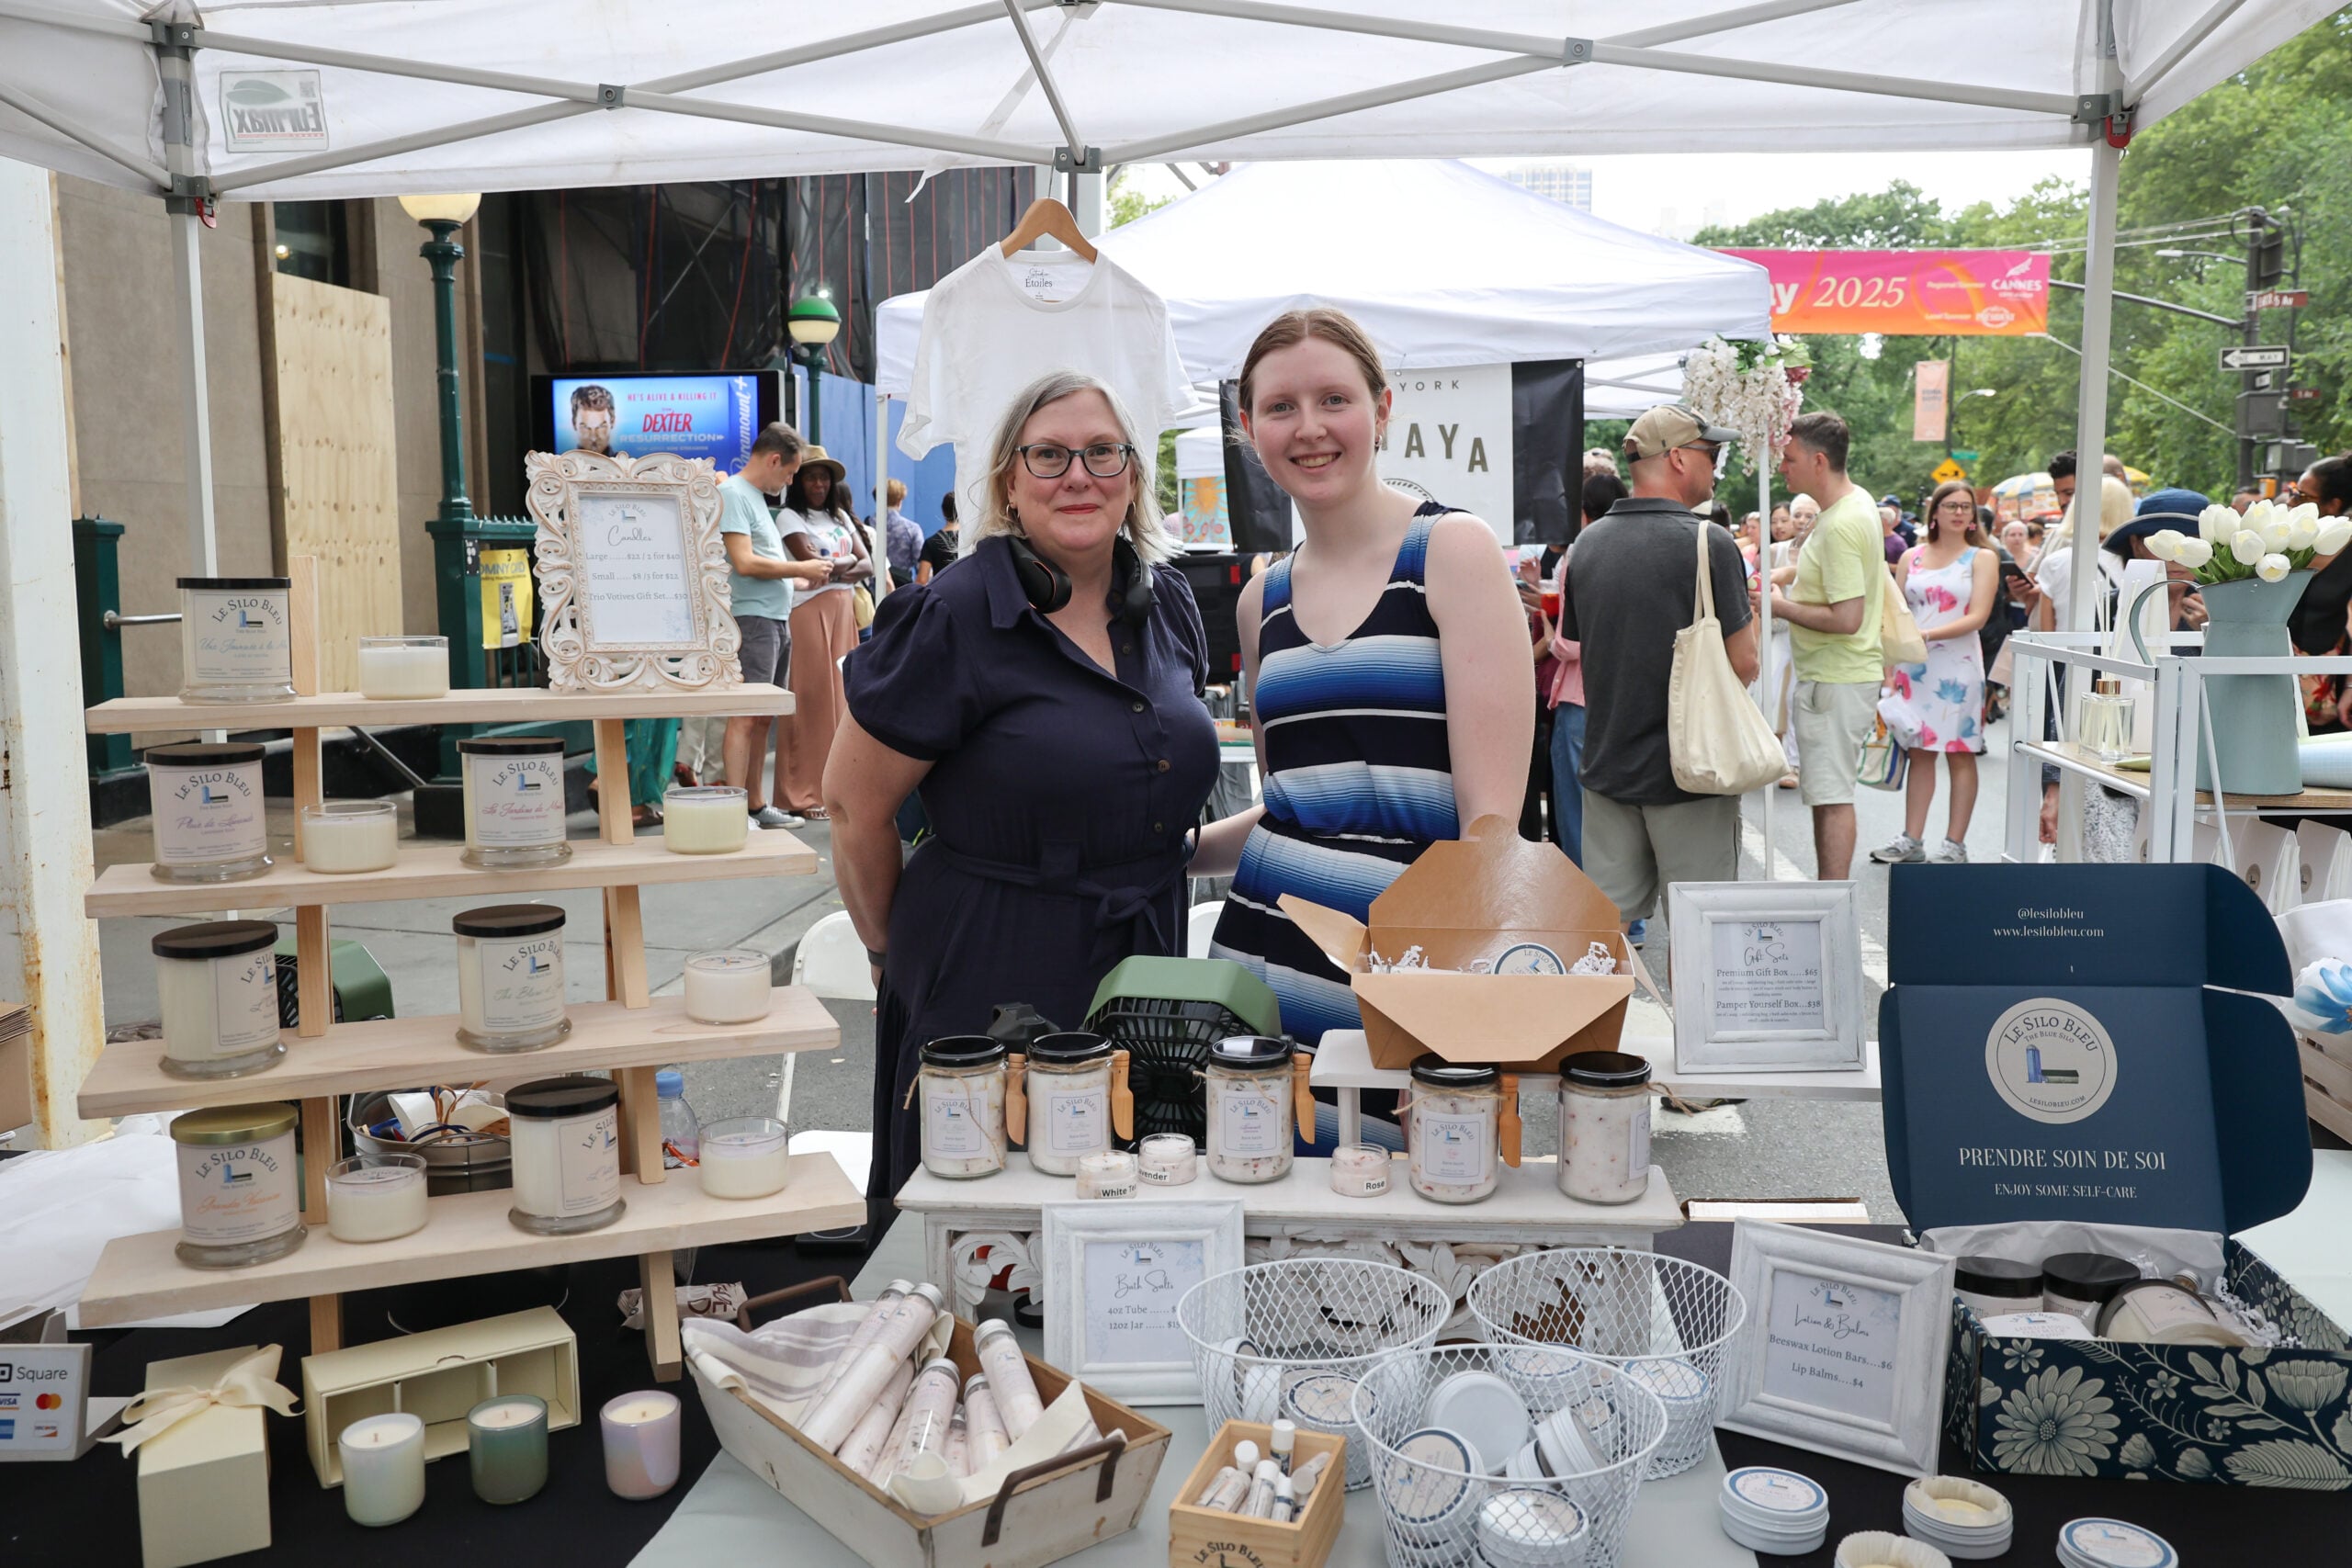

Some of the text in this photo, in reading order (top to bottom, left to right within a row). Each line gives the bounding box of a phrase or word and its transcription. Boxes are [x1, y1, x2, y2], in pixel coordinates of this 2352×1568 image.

[1813, 276, 1906, 308] 2025
[1991, 279, 2042, 291] CANNES
[1399, 380, 1459, 392] YORK
[647, 393, 667, 401] ALIVE
[678, 391, 707, 401] KILLING
[709, 391, 718, 400] IT
[642, 410, 692, 433] DEXTER
[619, 433, 718, 443] RESURRECTION
[607, 525, 651, 547] Candles
[586, 552, 608, 561] Large
[653, 552, 664, 560] for
[592, 572, 615, 581] Small
[211, 598, 282, 626] LE SILO BLEU
[492, 761, 558, 786] LE SILO BLEU
[175, 772, 251, 800] LE SILO BLEU
[2018, 908, 2084, 920] @lesilobleu
[1993, 925, 2104, 938] www.lesilobleu.com
[503, 956, 519, 971] LE
[518, 942, 546, 959] SILO
[241, 967, 256, 984] LE
[1756, 968, 1771, 976] Gift
[1716, 1001, 1747, 1010] Pamper
[1748, 999, 1783, 1009] Yourself
[2004, 1016, 2098, 1052] LE SILO BLEU
[2024, 1033, 2039, 1043] THE
[2059, 1032, 2075, 1043] SILO
[2030, 1095, 2086, 1108] LESILOBLEU.COM
[582, 1134, 596, 1149] LE
[196, 1147, 278, 1179] LE SILO BLEU
[1959, 1147, 2166, 1171] PRENDRE SOIN DE SOI
[1365, 1179, 1385, 1190] Rose
[1995, 1182, 2138, 1199] ENJOY SOME SELF-CARE
[1102, 1188, 1127, 1197] White
[1114, 1269, 1173, 1299] Bath Salts
[1125, 1305, 1148, 1314] Tube
[1109, 1322, 1128, 1330] 12oz
[1130, 1321, 1143, 1330] Jar
[1794, 1303, 1869, 1339] Lotion & Balms
[1770, 1334, 1809, 1351] Beeswax
[1812, 1343, 1842, 1359] Lotion
[16, 1367, 68, 1382] Square
[1792, 1362, 1807, 1376] Lip
[1193, 1549, 1209, 1564] LE
[1207, 1541, 1236, 1553] SILO
